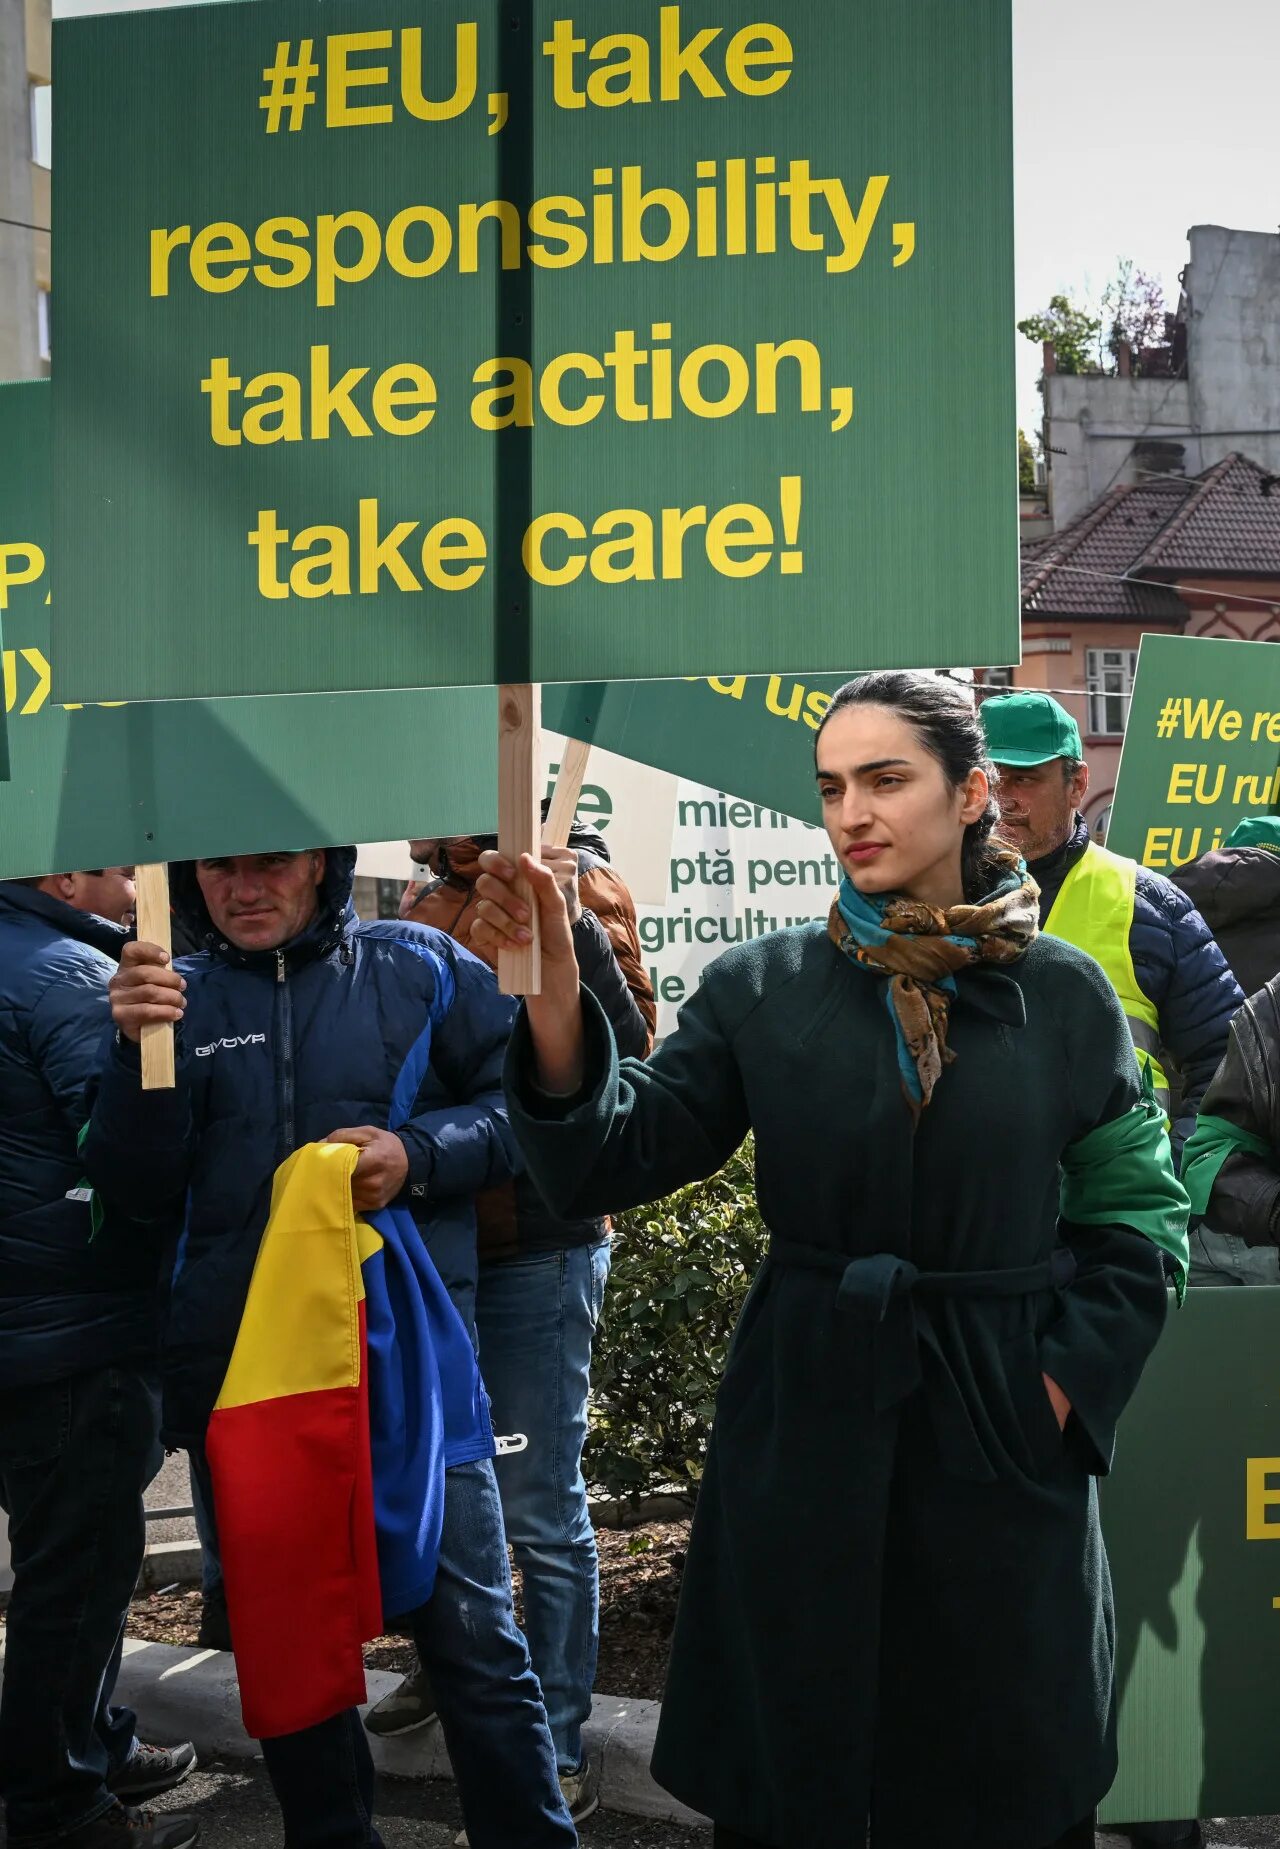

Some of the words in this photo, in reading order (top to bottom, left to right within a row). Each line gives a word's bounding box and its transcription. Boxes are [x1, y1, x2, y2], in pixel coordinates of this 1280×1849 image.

[259, 22, 510, 135] #EU,
[543, 5, 794, 109] take
[150, 156, 916, 307] responsibility,
[201, 345, 437, 446] take
[470, 322, 854, 433] action,
[248, 498, 488, 599] take
[521, 475, 803, 587] care!
[1156, 697, 1242, 741] #We
[1166, 763, 1226, 804] EU
[1142, 828, 1202, 868] EU
[195, 1033, 266, 1057] GIVOVA
